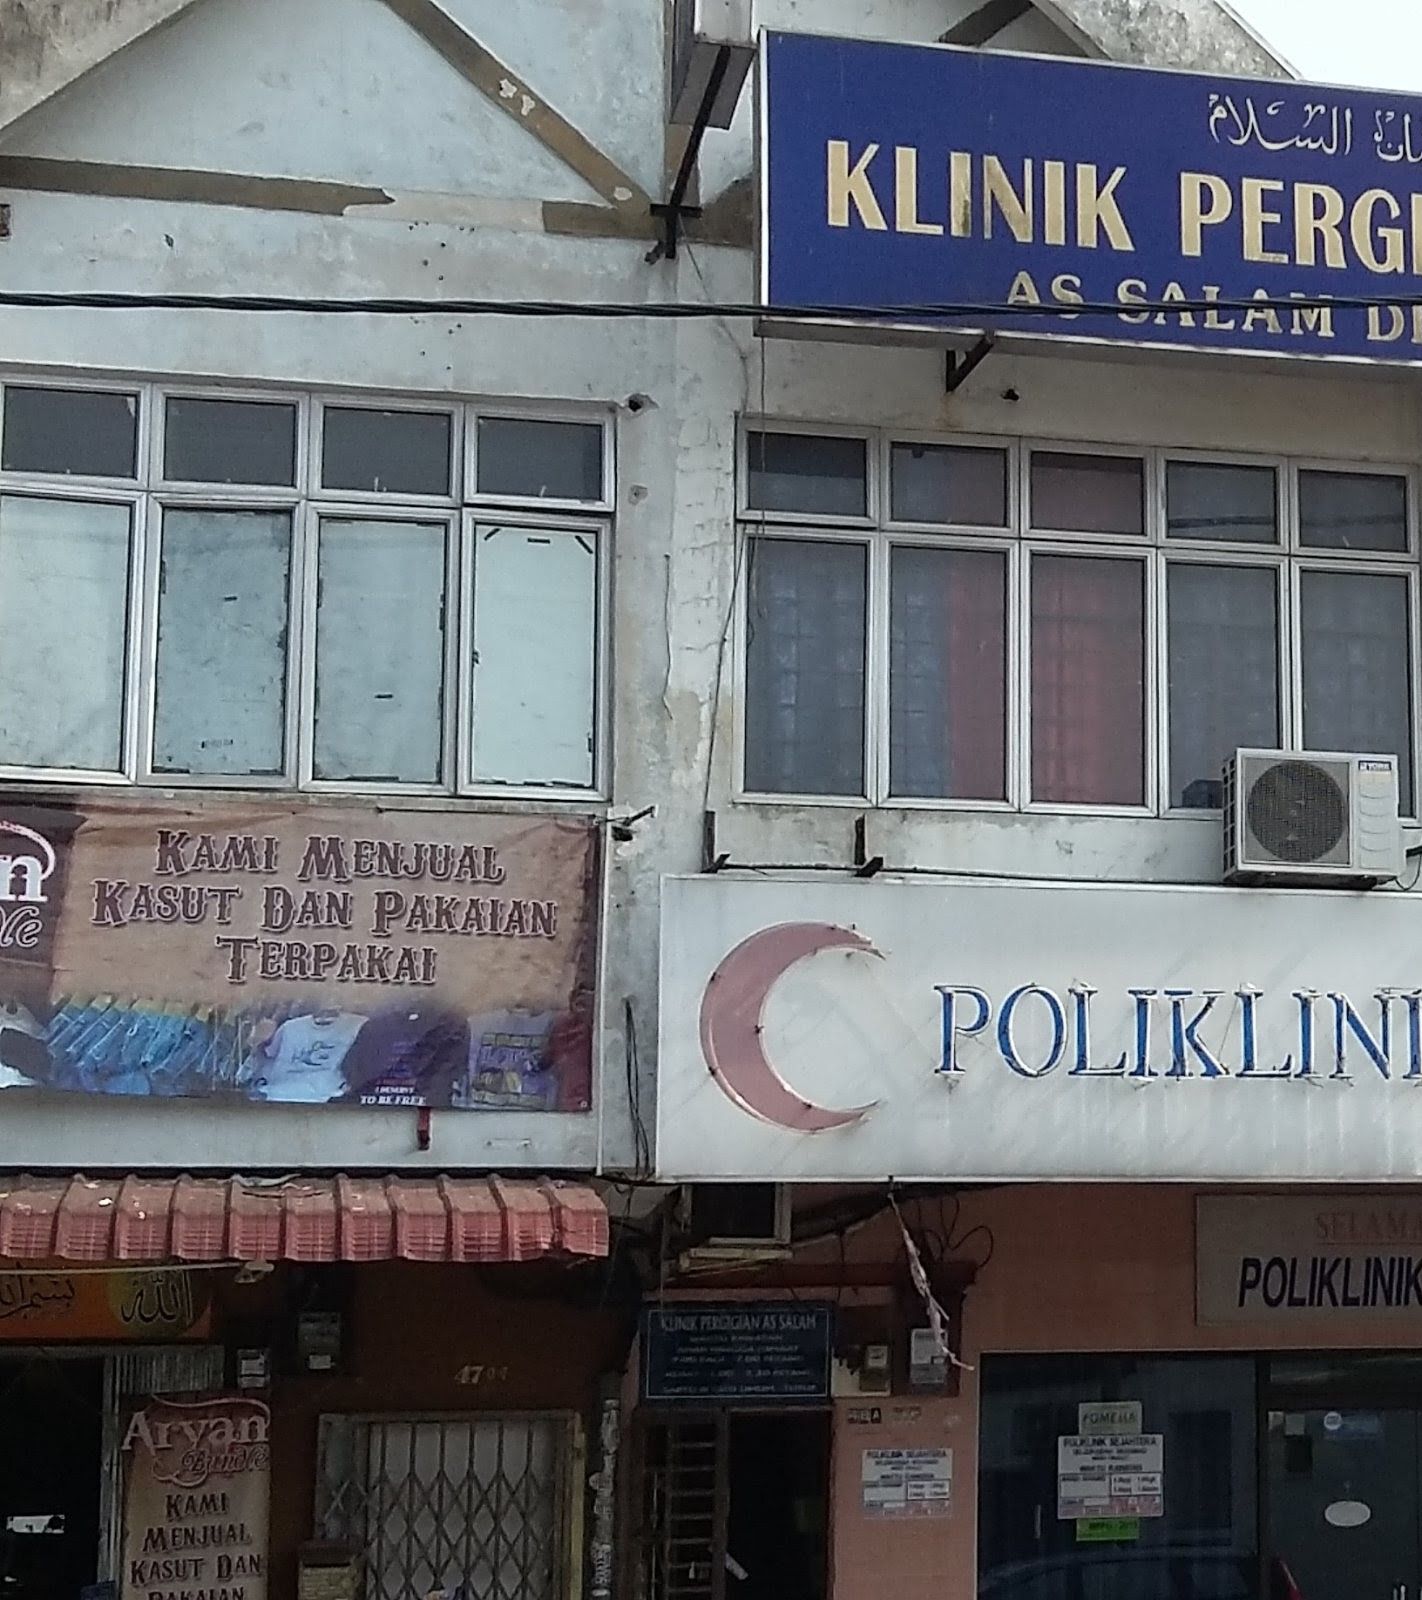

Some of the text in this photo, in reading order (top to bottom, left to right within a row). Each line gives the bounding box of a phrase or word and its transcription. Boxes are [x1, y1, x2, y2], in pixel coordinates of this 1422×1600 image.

[826, 139, 1135, 252] KLINIK
[1007, 270, 1084, 320] AS
[1117, 278, 1335, 338] SALAM
[155, 829, 505, 884] KAMI MENJUAL
[91, 877, 242, 928] KASUT
[260, 885, 352, 933] DAN
[371, 891, 558, 938] PAKAIAN
[215, 935, 438, 985] TERPAKAI
[121, 1406, 269, 1458] Aryan
[166, 1492, 229, 1520] KAMI
[142, 1524, 252, 1553] MENJUAL
[130, 1553, 262, 1585] KASUT DAN
